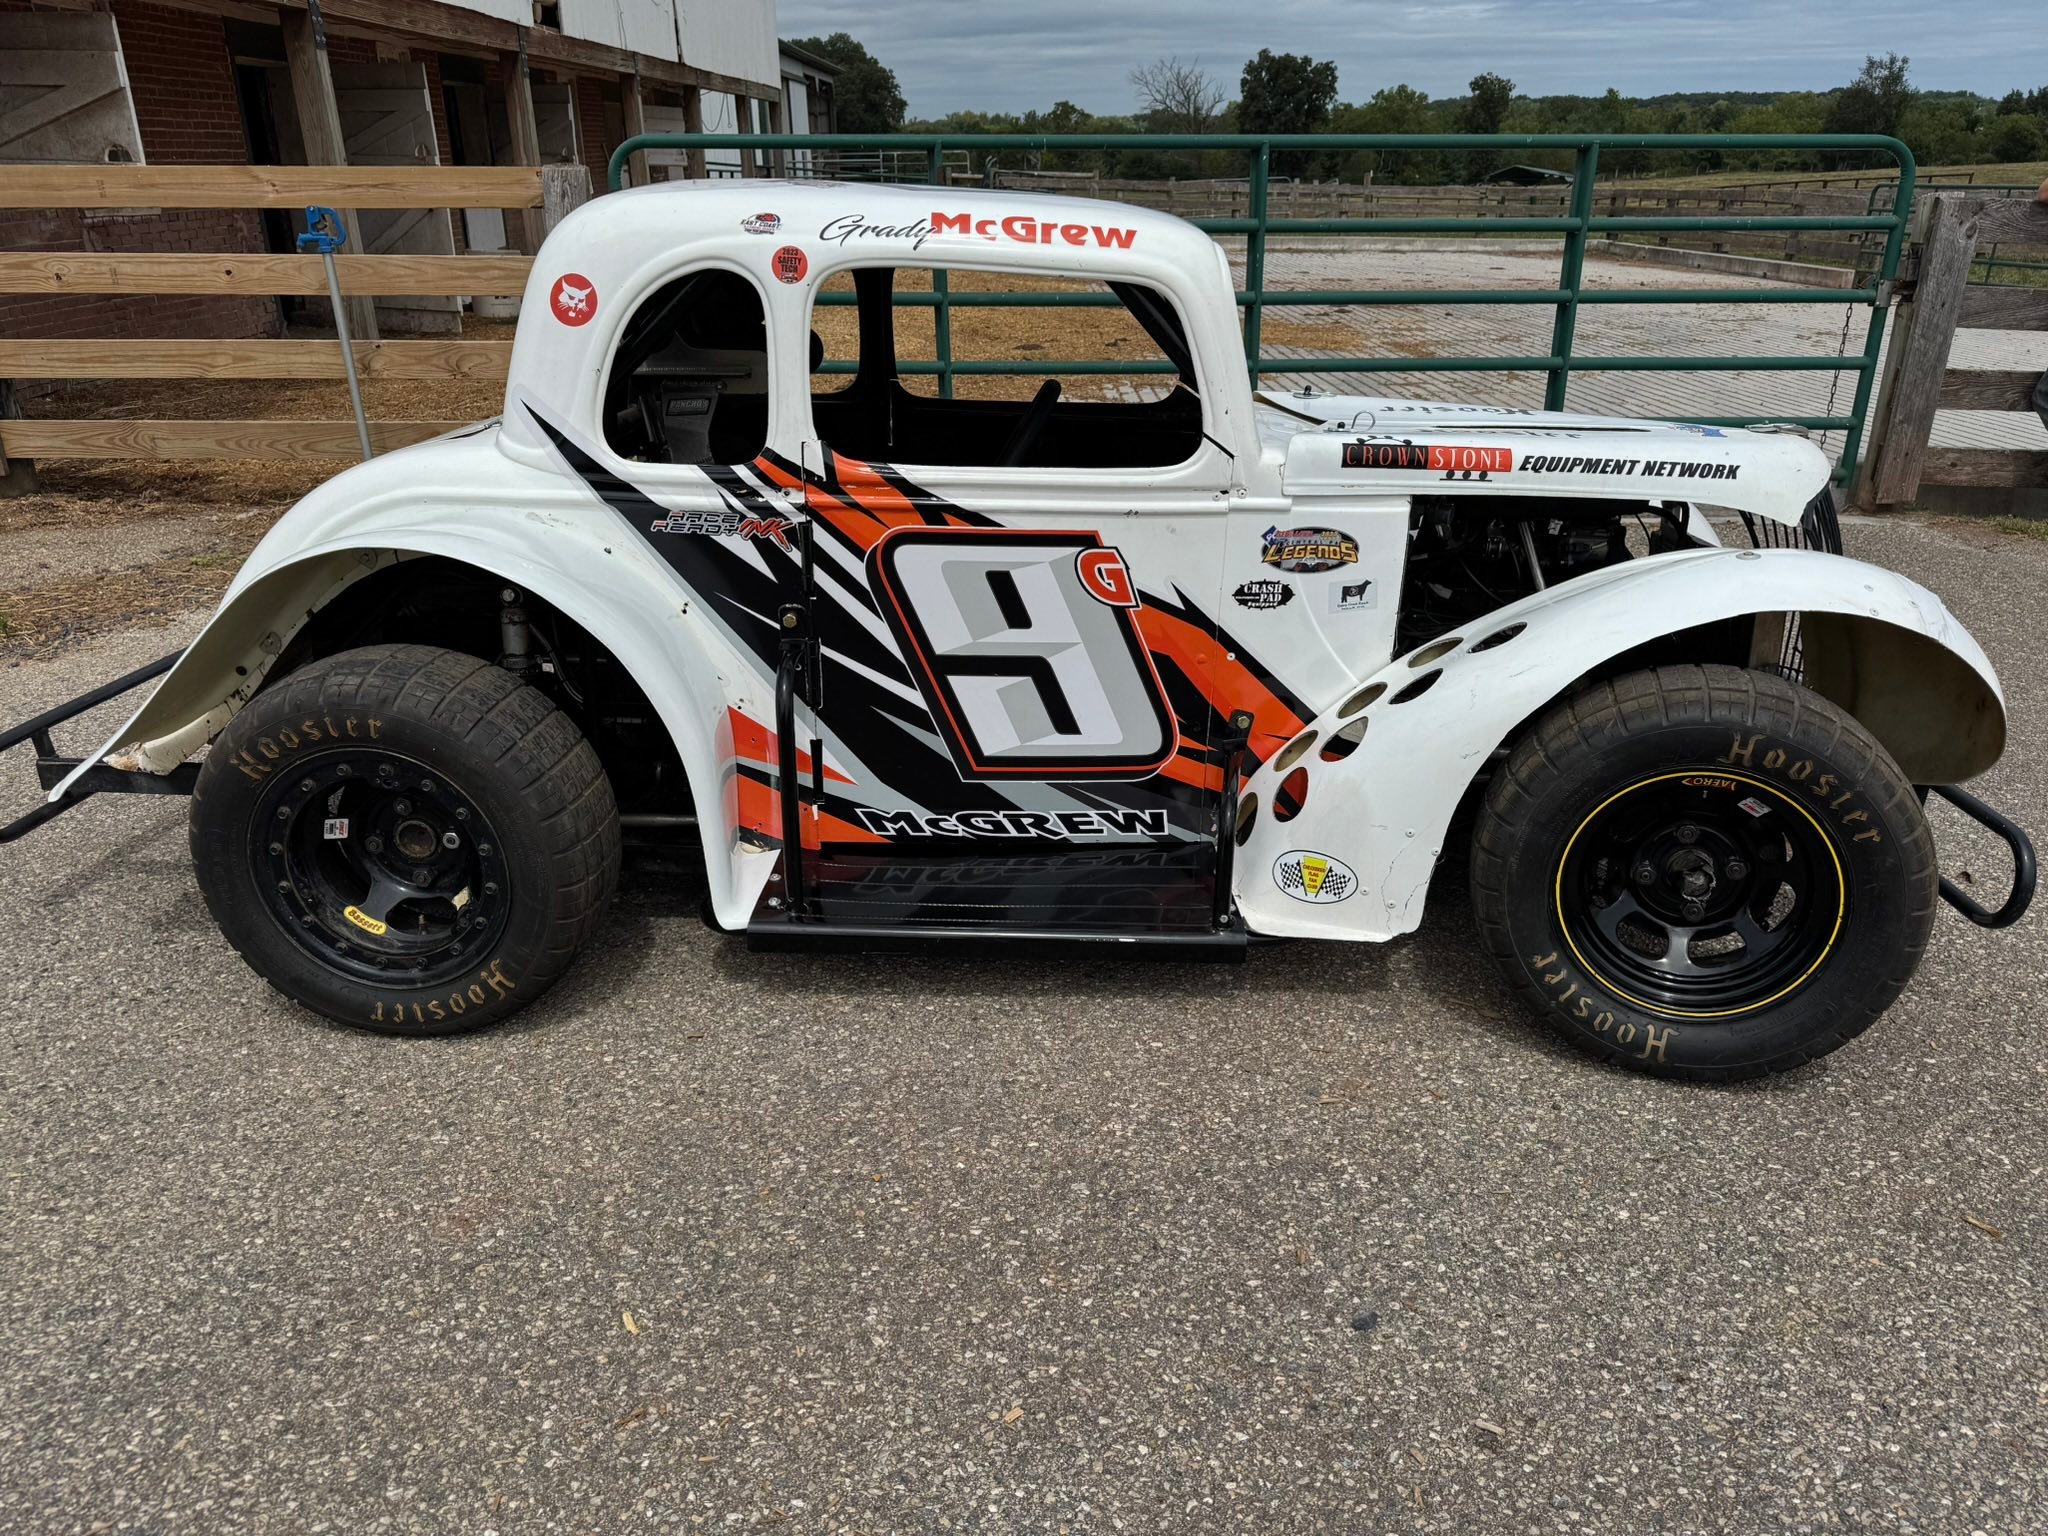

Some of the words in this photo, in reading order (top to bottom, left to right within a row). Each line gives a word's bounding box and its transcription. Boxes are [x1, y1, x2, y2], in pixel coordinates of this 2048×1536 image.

[819, 214, 937, 251] Grady
[930, 211, 1138, 249] McGrew
[777, 256, 802, 266] SAFETY
[781, 264, 798, 273] TECH
[1518, 455, 1640, 474] EQUIPMENT
[1640, 459, 1742, 480] NETWORK
[1243, 583, 1283, 593] CRASH
[1260, 593, 1282, 602] PAD
[229, 716, 384, 783] Hoosier
[1715, 730, 1882, 842] Hoosier
[854, 807, 1170, 840] McGREW
[369, 957, 517, 1024] Hoosier
[1533, 951, 1681, 1064] Hoosier
